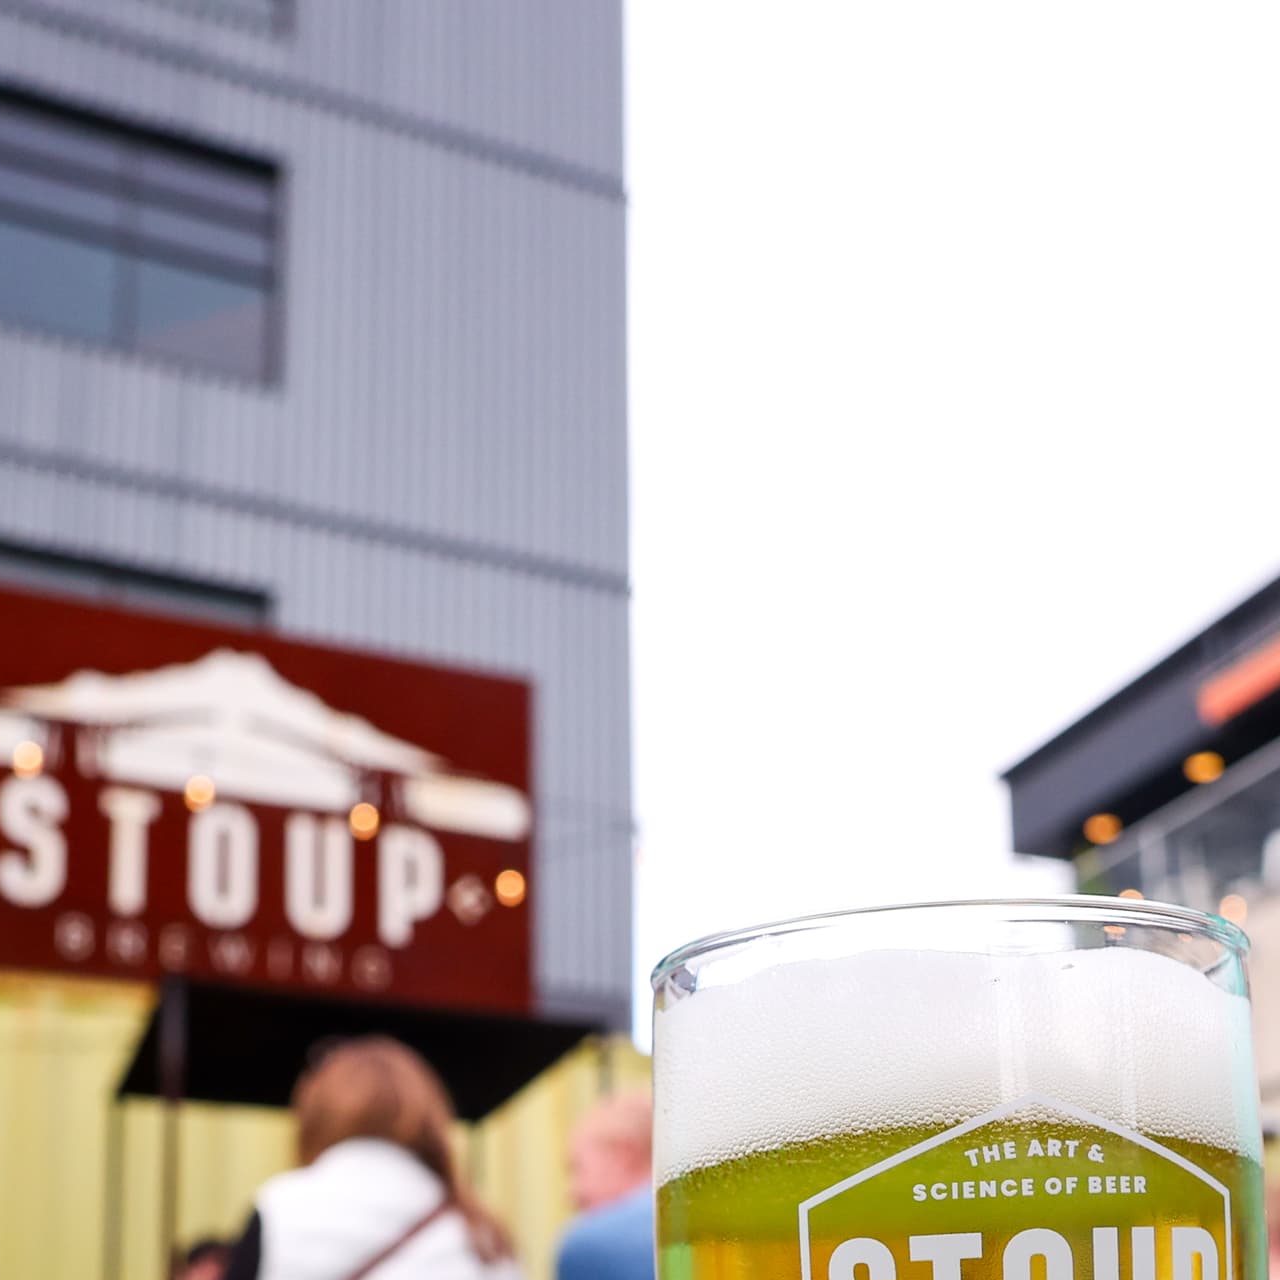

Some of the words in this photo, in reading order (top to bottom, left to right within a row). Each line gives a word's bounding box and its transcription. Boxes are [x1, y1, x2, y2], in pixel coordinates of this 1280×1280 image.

[965, 1141, 1017, 1167] THE
[1027, 1138, 1079, 1158] ART
[1087, 1144, 1106, 1164] &
[912, 1178, 1035, 1202] SCIENCE
[1044, 1177, 1078, 1195] OF
[1087, 1175, 1148, 1195] BEER
